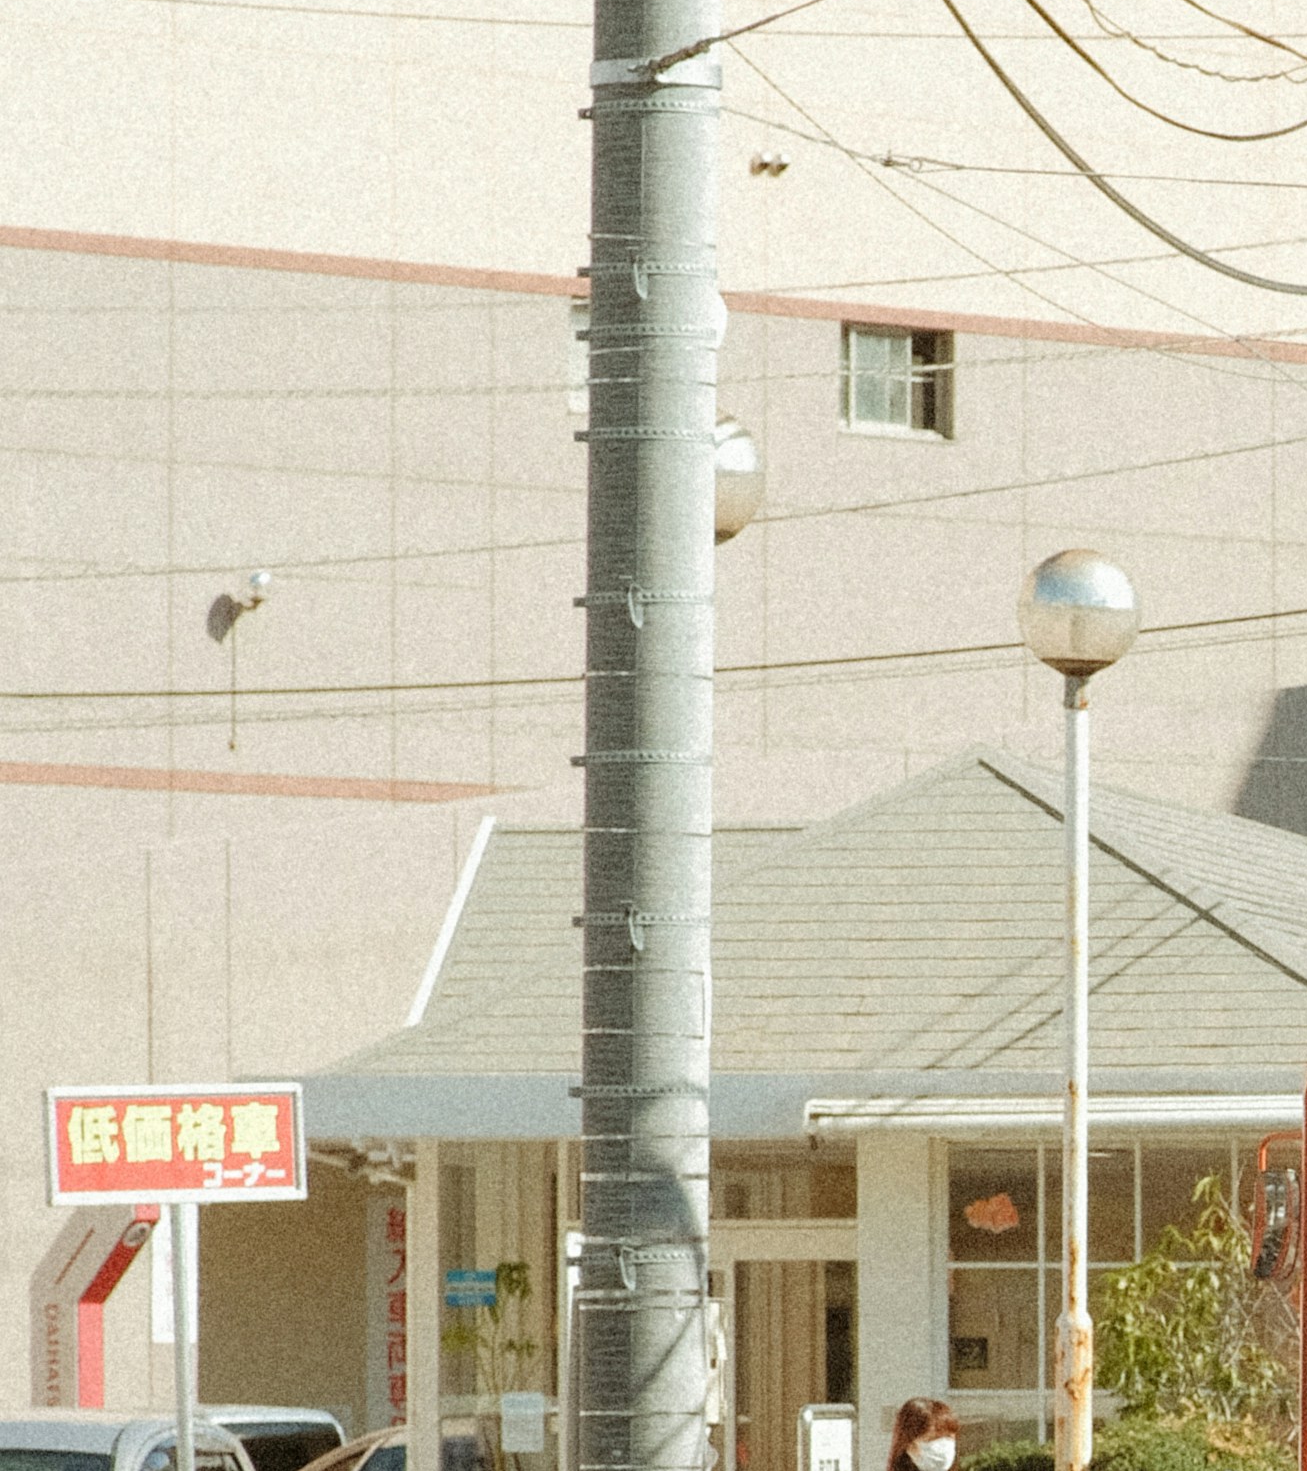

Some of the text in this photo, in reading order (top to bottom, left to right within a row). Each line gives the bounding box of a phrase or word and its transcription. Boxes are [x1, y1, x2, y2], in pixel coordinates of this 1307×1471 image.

[67, 1101, 281, 1165] 低価格車
[202, 1162, 286, 1188] コーナー
[45, 1303, 60, 1407] DAIHATS
